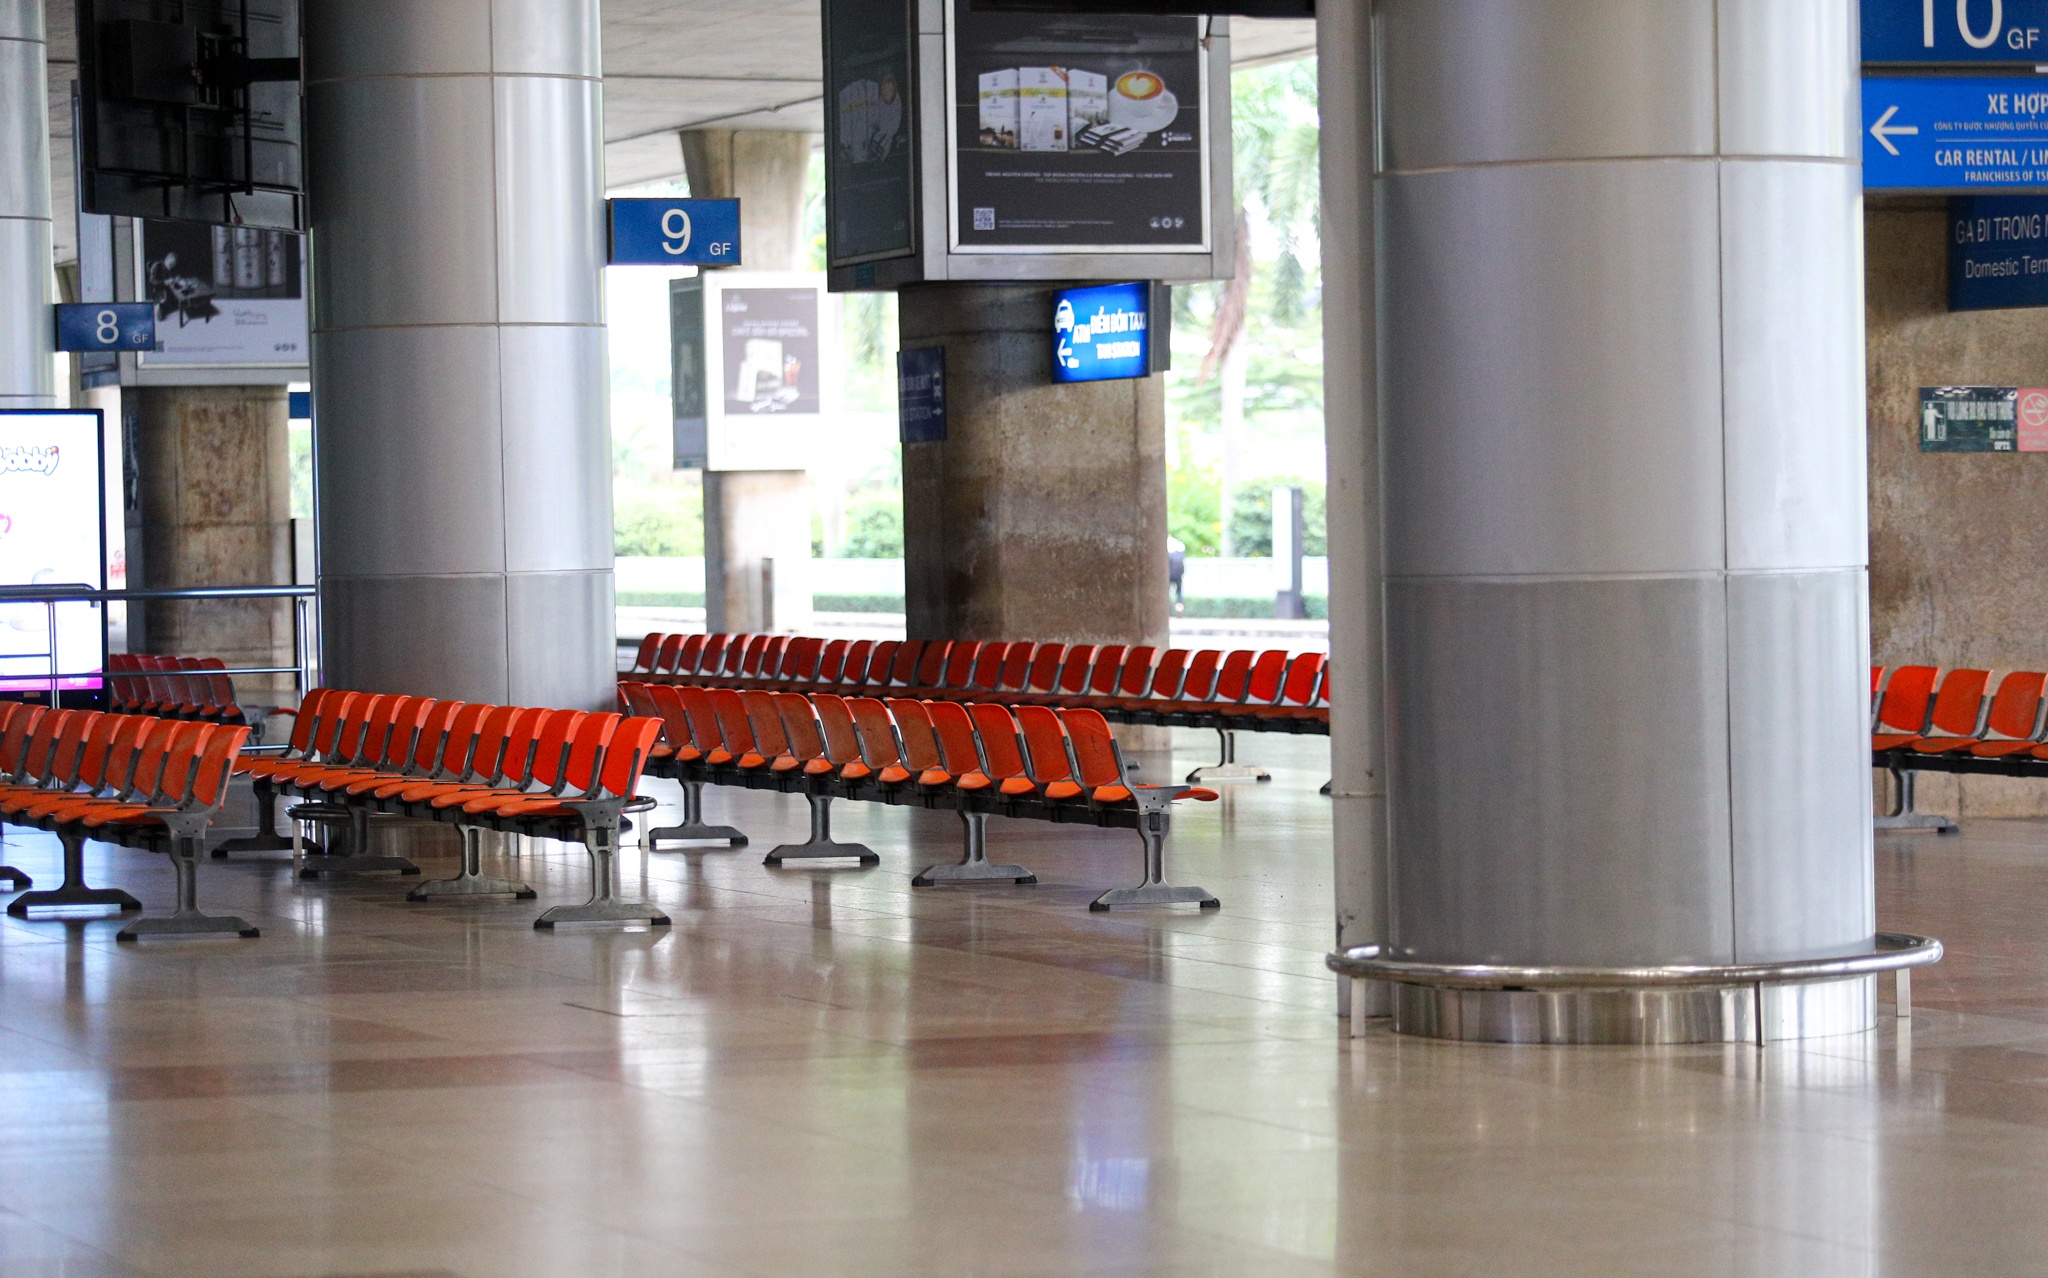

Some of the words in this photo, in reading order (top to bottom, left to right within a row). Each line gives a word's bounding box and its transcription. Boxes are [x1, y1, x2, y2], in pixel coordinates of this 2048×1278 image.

[1923, 0, 2003, 49] 10
[2007, 28, 2040, 50] GF
[1987, 93, 2009, 115] XE
[1934, 149, 1963, 167] CAR
[1966, 149, 2019, 167] RENTAL
[2021, 149, 2028, 167] /
[2031, 149, 2048, 167] LI
[1964, 170, 2021, 183] FRANCHISES
[2022, 170, 2034, 182] OF
[660, 207, 692, 256] 9
[709, 242, 732, 256] GF
[1955, 219, 1975, 245] GA
[1977, 217, 1991, 243] ĐI
[1993, 213, 2041, 241] TRONG
[1965, 256, 2019, 279] Domestic
[96, 309, 120, 345] 8
[132, 334, 149, 345] GF
[1129, 312, 1147, 331] TAXI
